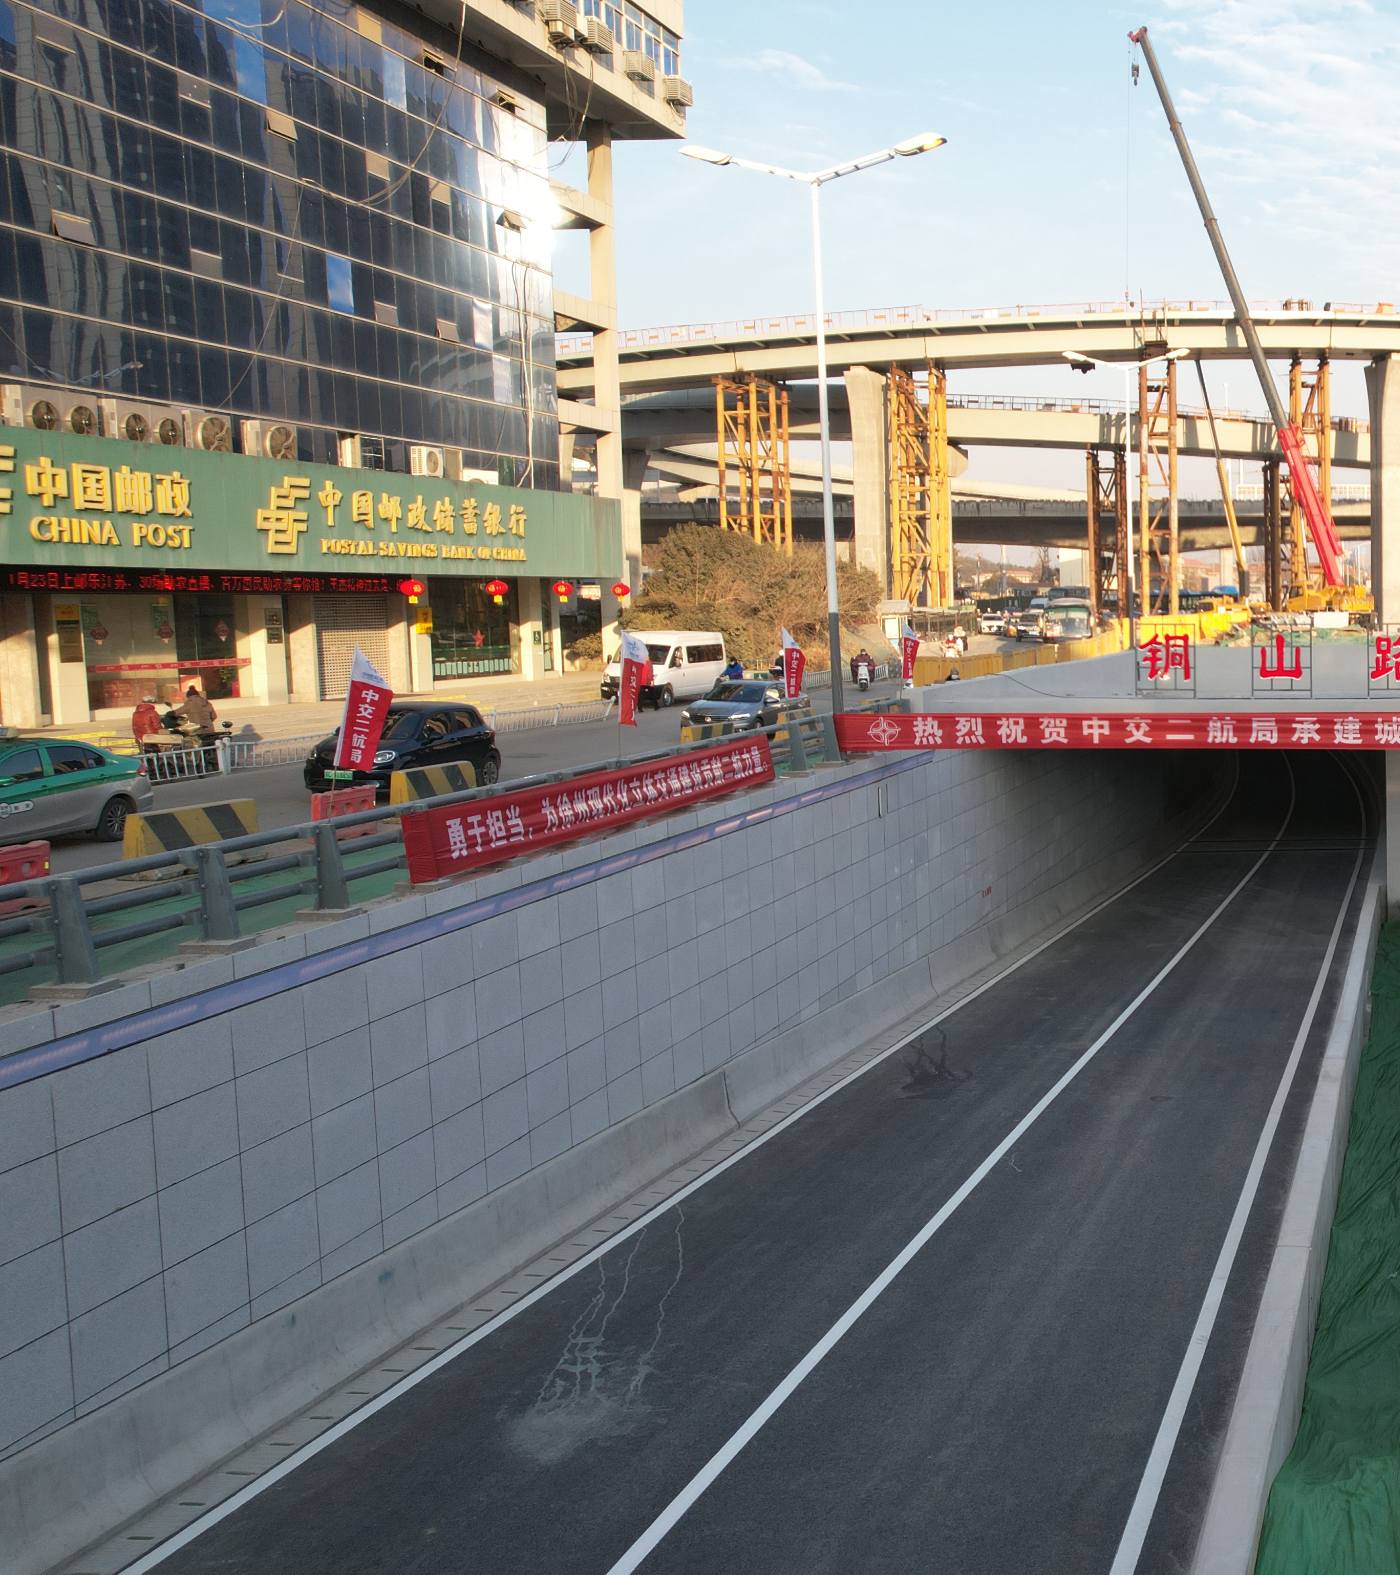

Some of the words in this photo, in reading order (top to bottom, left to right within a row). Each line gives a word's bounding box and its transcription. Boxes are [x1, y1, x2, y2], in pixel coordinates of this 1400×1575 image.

[25, 456, 192, 517] 中国邮政
[318, 480, 527, 537] 中国邮政储蓄银行
[30, 516, 120, 546] CHINA
[131, 522, 194, 548] POST
[320, 538, 377, 555] POSTAL
[379, 541, 438, 558] SAVINGS
[441, 544, 475, 559] BANK
[492, 546, 527, 561] CHINA
[350, 689, 379, 763] 中交二航局
